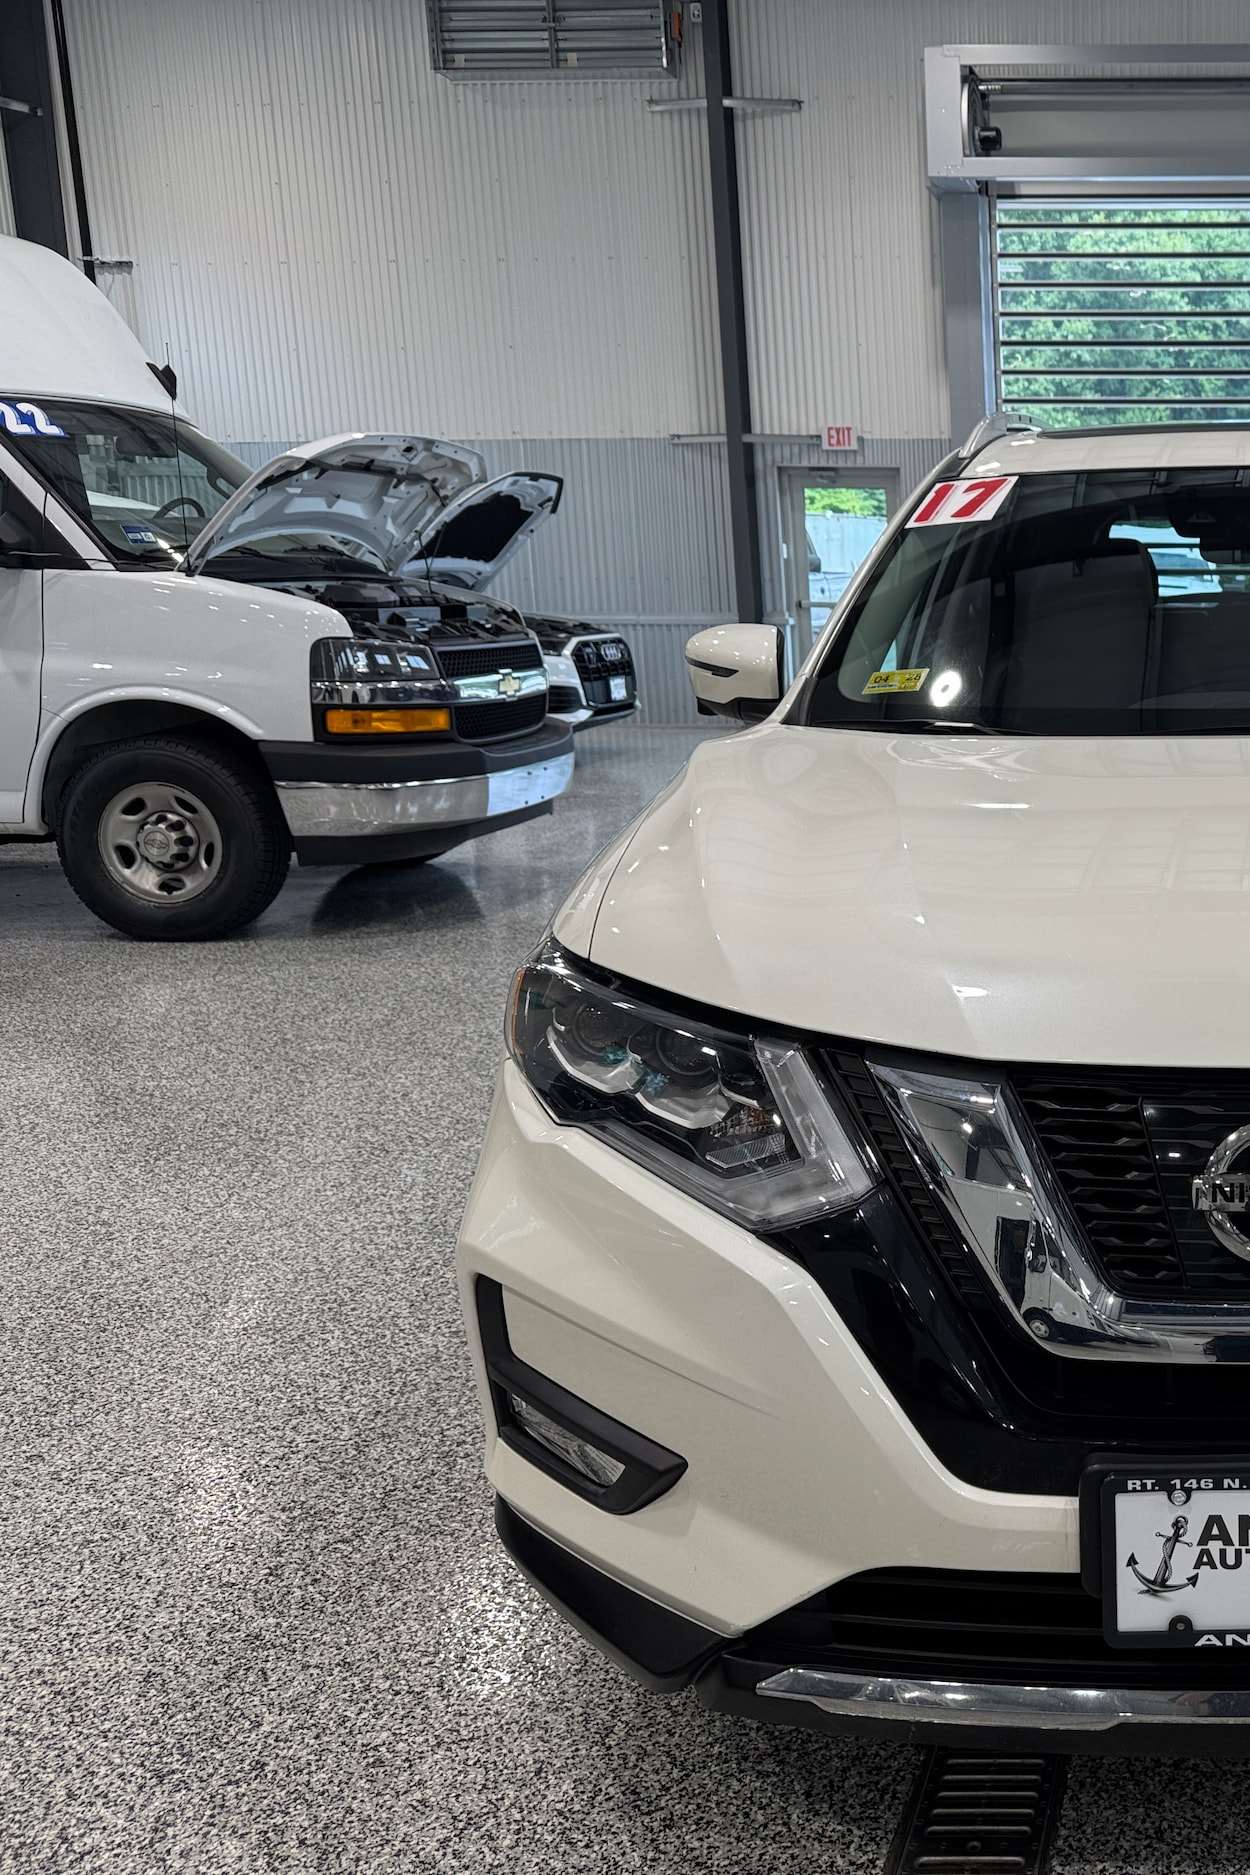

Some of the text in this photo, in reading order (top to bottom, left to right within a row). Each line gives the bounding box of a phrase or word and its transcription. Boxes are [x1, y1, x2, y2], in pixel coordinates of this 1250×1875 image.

[827, 426, 852, 447] EXIT
[914, 478, 1008, 523] 17
[1127, 1478, 1158, 1491] RT.
[1171, 1477, 1214, 1490] 146
[1224, 1477, 1247, 1489] N.
